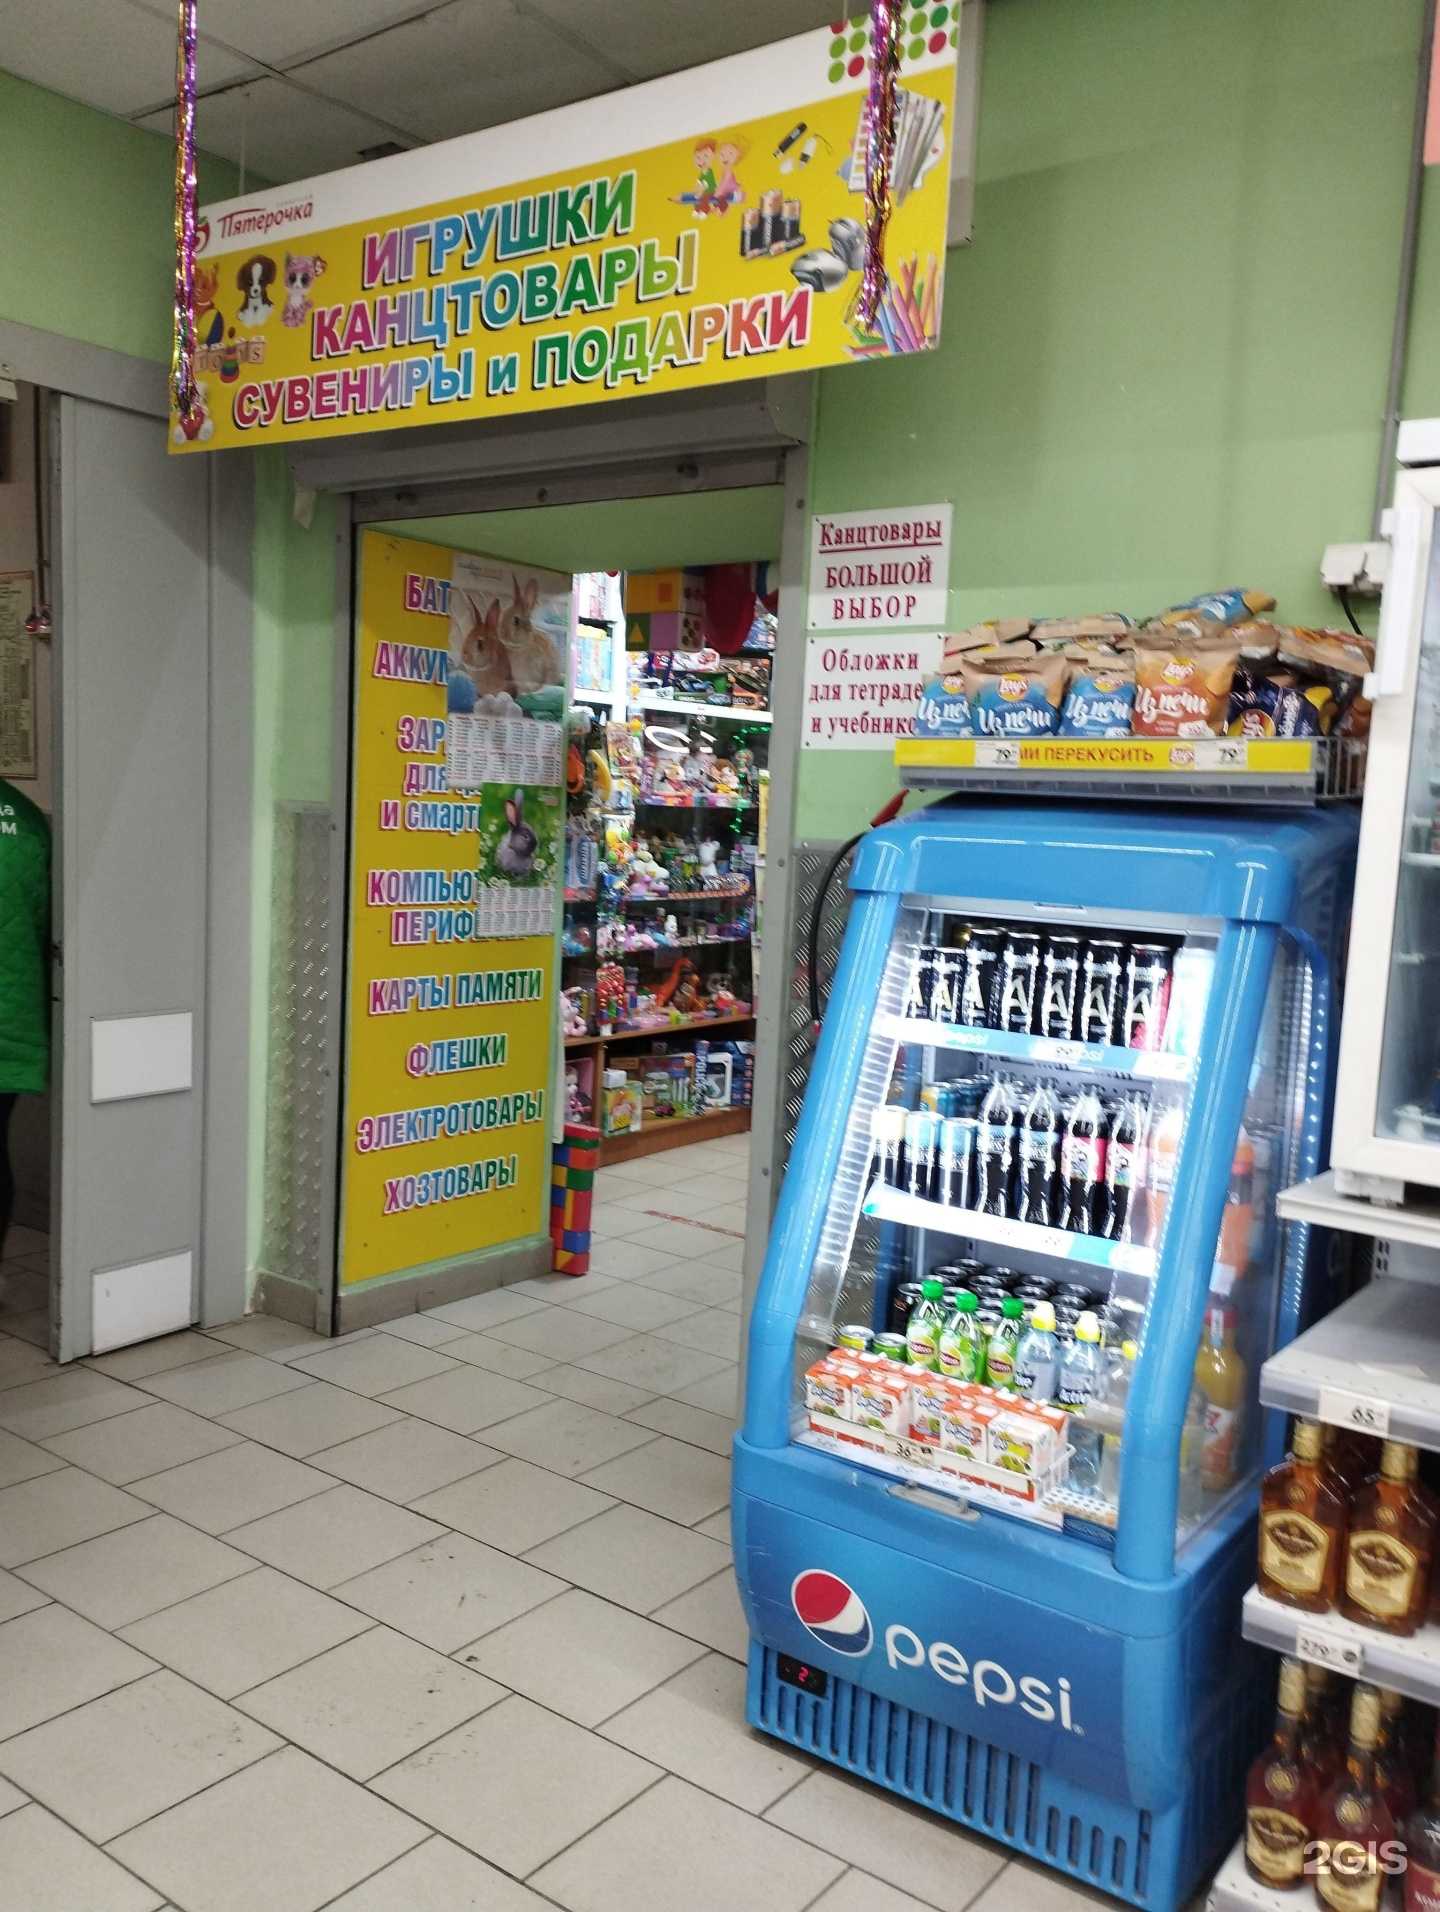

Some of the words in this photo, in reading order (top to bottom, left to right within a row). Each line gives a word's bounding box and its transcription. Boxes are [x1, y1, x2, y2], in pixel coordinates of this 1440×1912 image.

[362, 170, 638, 289] ИГРУШКИ
[311, 230, 699, 361] КАНЦТОВАРЫ
[233, 348, 475, 430] СУВЕНИРЫ
[533, 285, 813, 388] ПОДАРКИ
[819, 520, 942, 546] Канцтовары
[826, 555, 933, 588] БОЛЬШОЙ
[406, 573, 450, 616] БАТ
[832, 595, 918, 619] ВЫБОР
[822, 649, 919, 672] Обложки
[809, 684, 841, 703] для
[849, 680, 923, 707] тетраде
[398, 715, 447, 753] ЗАР
[812, 717, 821, 733] и
[1045, 747, 1154, 762] ПЕРЕКУСИТЬ
[368, 869, 480, 906] КОМПЬЮ
[391, 908, 477, 945] ПЕРИФ
[370, 976, 451, 1015] КАРТЫ
[455, 969, 544, 1007] ПАМЯТИ
[406, 1034, 508, 1077] ФЛЕШКИ
[357, 1090, 544, 1152] ЭЛЕКТРОТОВАРЫ
[384, 1155, 518, 1214] ХОЗТОВАРЫ
[885, 1624, 1074, 1731] pepsi
